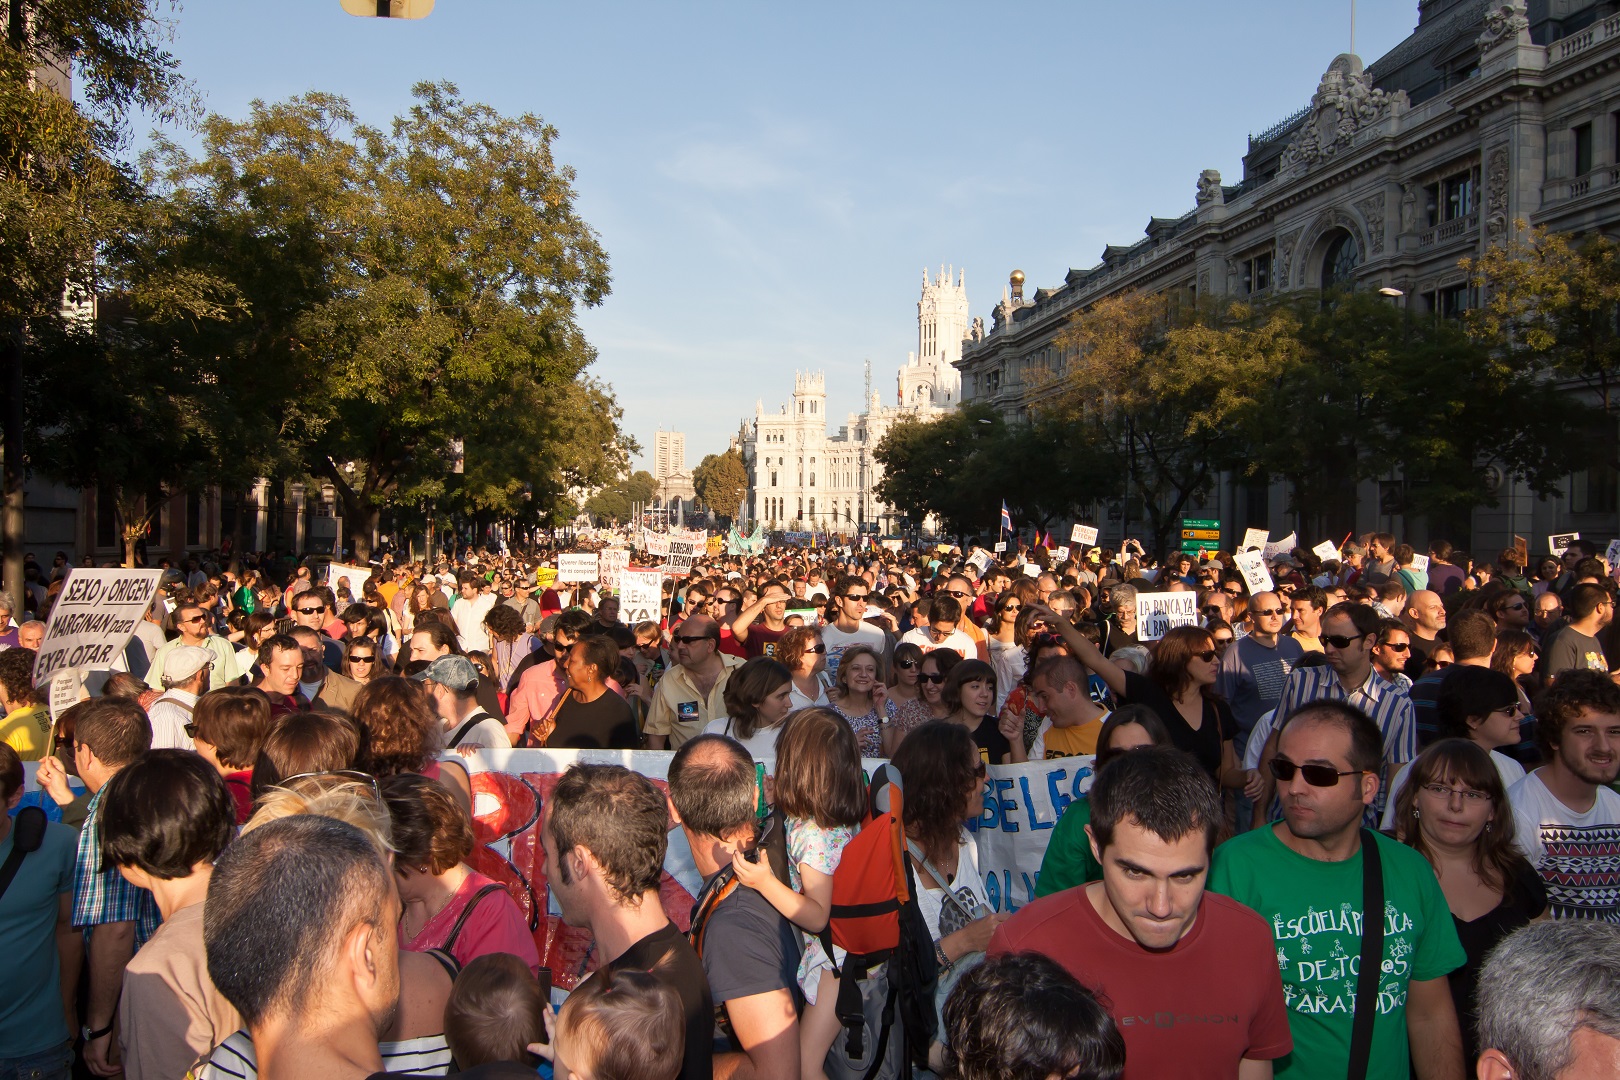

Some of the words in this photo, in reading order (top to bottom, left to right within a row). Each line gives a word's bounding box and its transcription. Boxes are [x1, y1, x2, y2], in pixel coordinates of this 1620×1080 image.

[668, 541, 694, 555] DERECHO
[560, 558, 578, 567] Querer
[666, 555, 673, 566] A
[673, 556, 692, 568] TECHO
[63, 578, 102, 602] SEXO
[92, 585, 110, 607] y
[107, 578, 155, 602] ORIGEN:
[1140, 600, 1151, 616] LA
[1153, 599, 1184, 616] BANCA,
[47, 613, 116, 641] MARGINAN
[104, 619, 135, 639] para
[1140, 619, 1152, 637] AL
[36, 644, 114, 679] EXPLOTAR.
[1274, 910, 1353, 940] ESCUELA
[1351, 911, 1413, 937] PICA:
[1297, 959, 1332, 982] DE
[1334, 953, 1408, 978] TO@S
